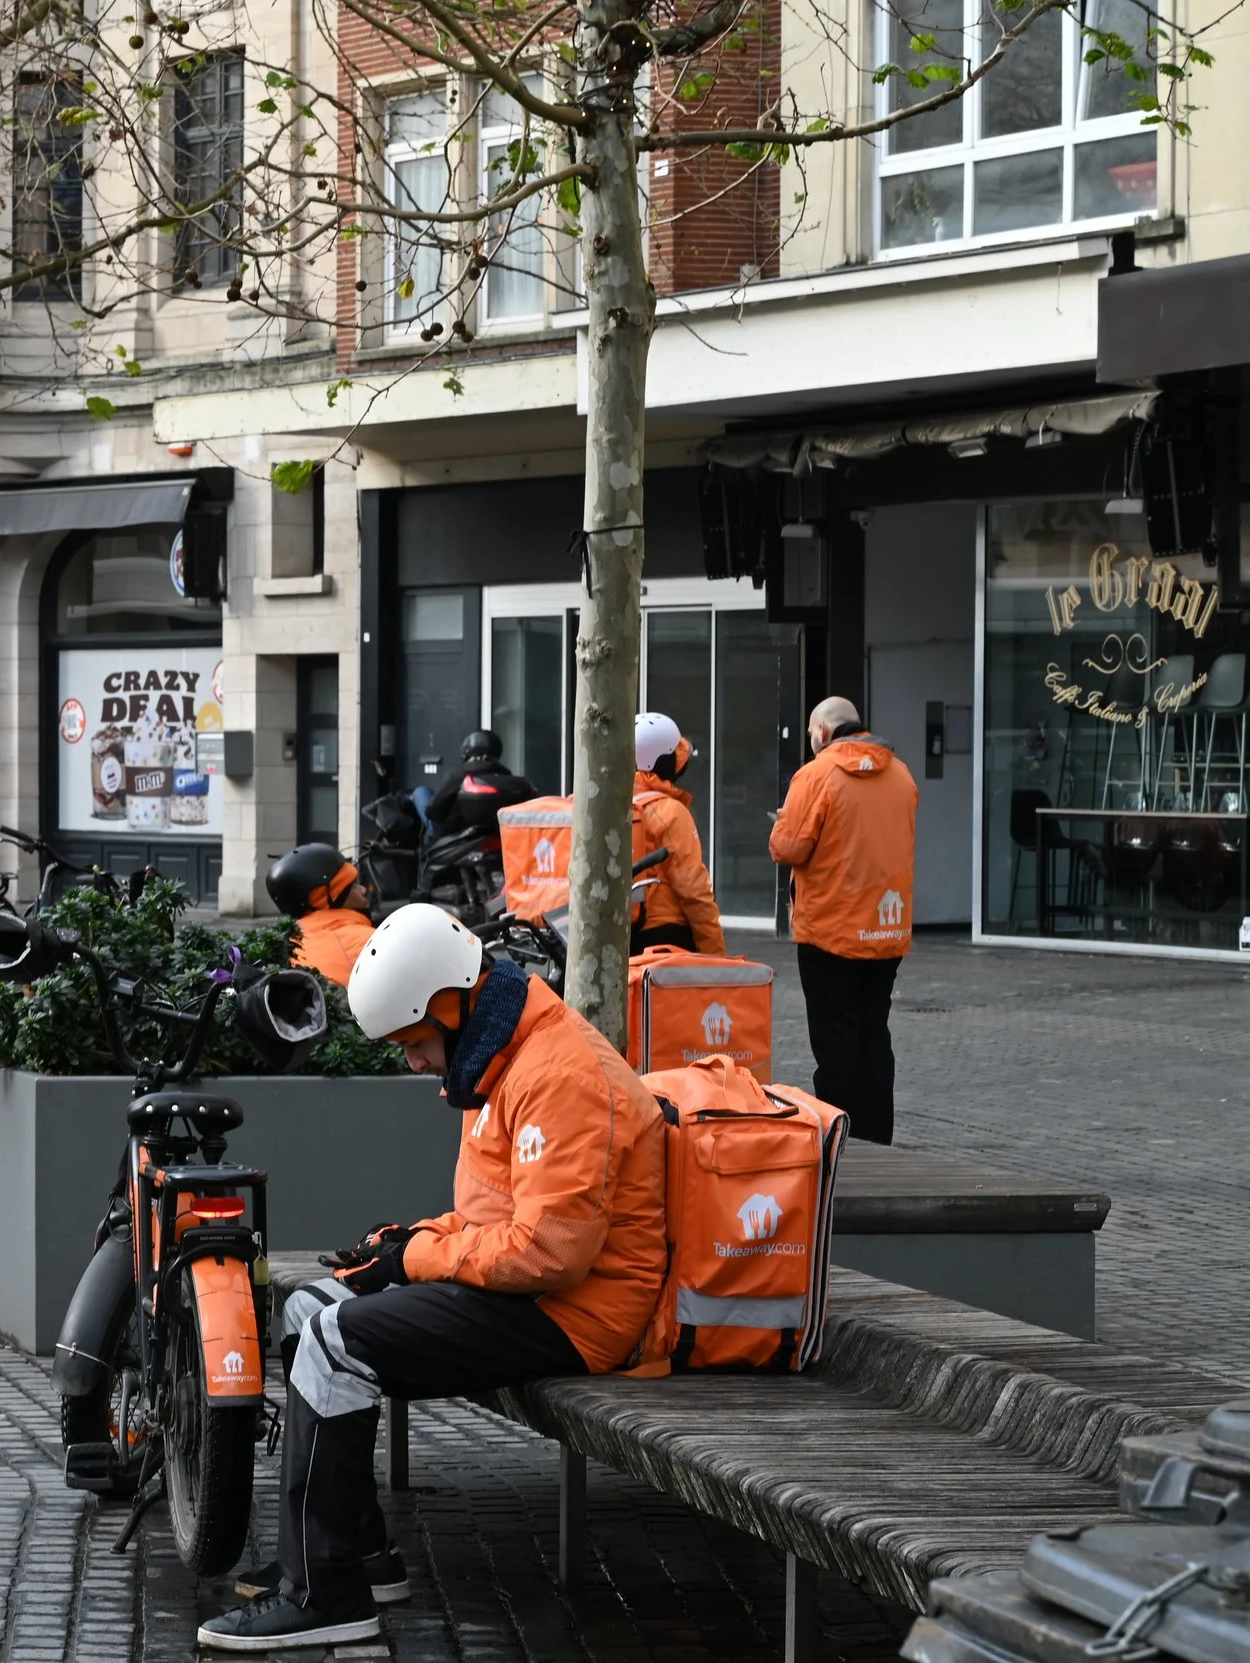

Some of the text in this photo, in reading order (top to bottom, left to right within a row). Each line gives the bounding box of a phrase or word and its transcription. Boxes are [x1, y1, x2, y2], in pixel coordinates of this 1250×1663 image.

[1088, 542, 1218, 639] Graal
[103, 670, 200, 694] CRAZY
[1074, 691, 1133, 724] Italiano
[713, 1241, 806, 1257] Takeaway.com
